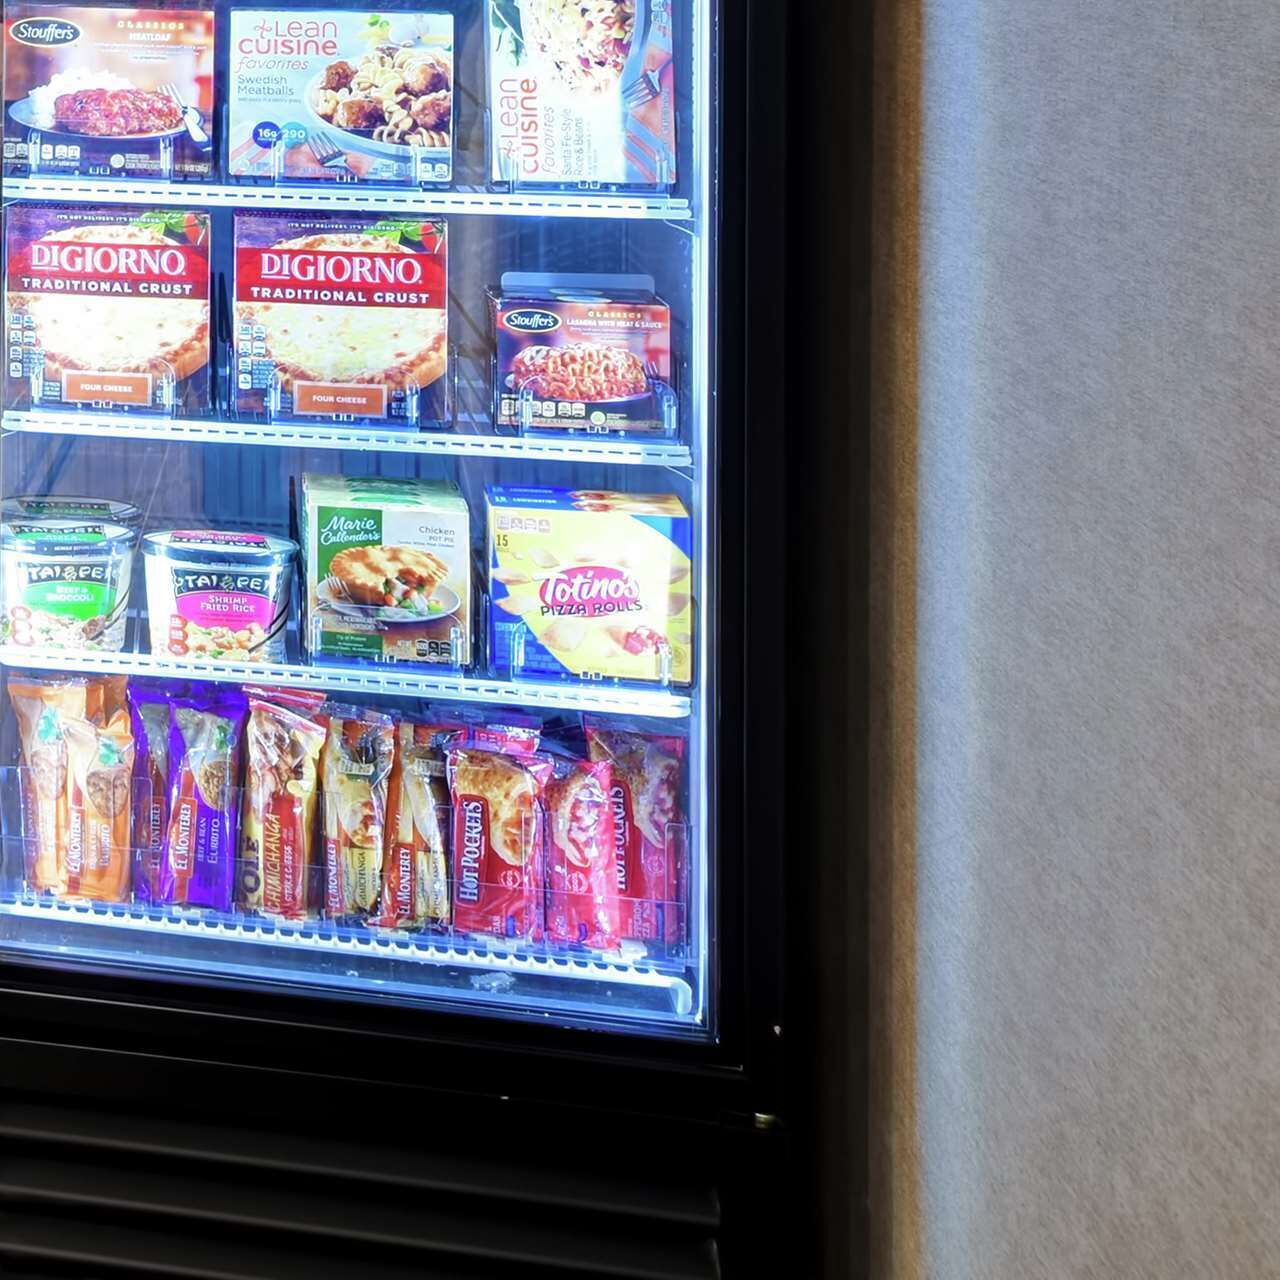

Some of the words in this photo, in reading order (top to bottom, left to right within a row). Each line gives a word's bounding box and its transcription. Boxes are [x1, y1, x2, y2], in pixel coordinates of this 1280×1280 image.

[18, 24, 74, 42] Stouffer's
[117, 20, 185, 30] CLASSICS
[275, 20, 337, 38] Lean
[235, 57, 308, 73] favorites
[238, 75, 287, 85] Swedish
[238, 86, 295, 96] Meatballs
[499, 79, 519, 138] Lean
[258, 128, 277, 138] 16g
[282, 129, 305, 138] 290
[573, 117, 582, 144] Beans
[542, 106, 555, 177] favorites
[574, 156, 583, 176] Rice
[31, 244, 186, 275] DIGIORNO
[261, 253, 422, 284] DIGIORNO
[21, 277, 132, 292] TRADITIONAL
[139, 283, 192, 295] CRUST
[251, 286, 367, 302] TRADITIONAL
[374, 292, 429, 304] CRUST
[510, 314, 555, 328] Stouffer's
[81, 383, 102, 392] FOUR
[103, 384, 132, 393] CHEESE
[336, 395, 367, 404] CHEESE
[321, 516, 377, 532] Marie
[419, 526, 455, 536] Chicken
[321, 531, 380, 545] Callender's
[496, 534, 508, 547] 15
[200, 603, 229, 612] FRIED
[232, 604, 255, 612] RICE
[209, 595, 247, 604] SHRIMP
[541, 604, 587, 616] PIZZA
[593, 600, 643, 612] ROLLS
[175, 803, 191, 850] MONTEREY
[461, 800, 482, 872] POCKETS
[176, 852, 187, 869] EL
[264, 813, 281, 911] CHIMICHANGA
[327, 843, 337, 892] MONTEREY
[398, 847, 411, 897] MONTEREY
[459, 874, 479, 903] HOT
[399, 898, 410, 914] EL
